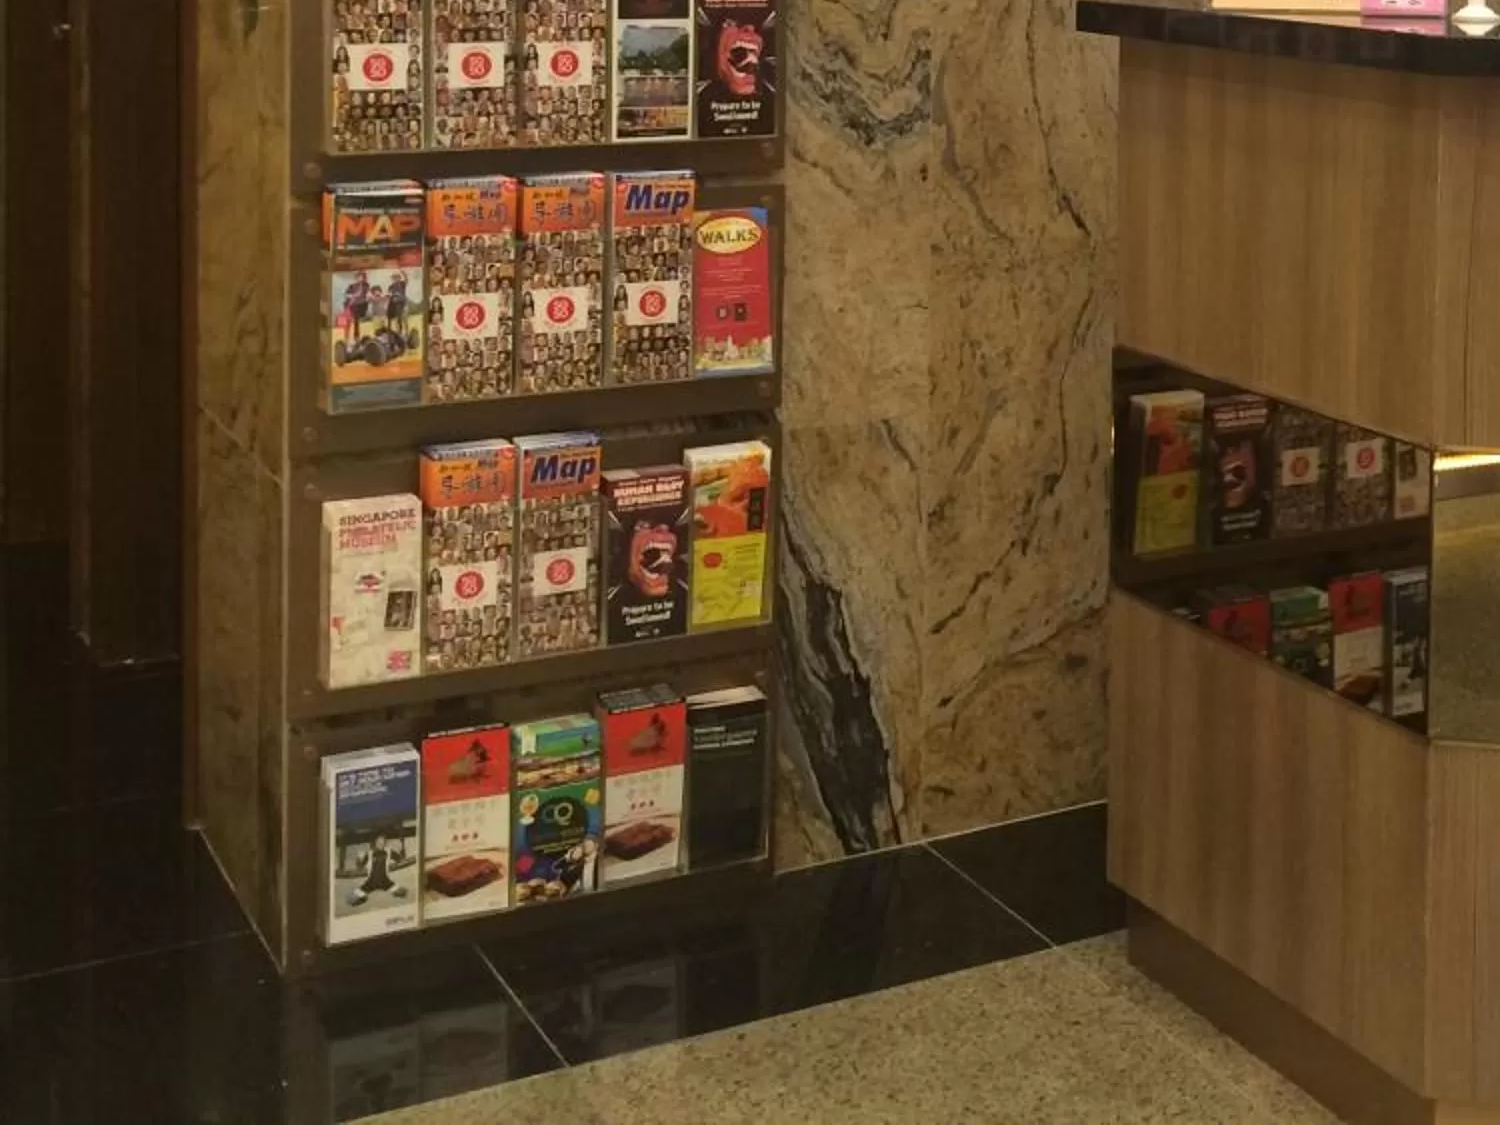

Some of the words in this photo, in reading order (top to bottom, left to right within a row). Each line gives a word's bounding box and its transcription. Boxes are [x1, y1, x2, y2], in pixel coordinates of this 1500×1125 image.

[624, 183, 691, 216] Map
[336, 213, 422, 249] MAP
[699, 227, 759, 245] WALKS
[531, 453, 598, 485] Map
[339, 507, 417, 527] SINGAPORE
